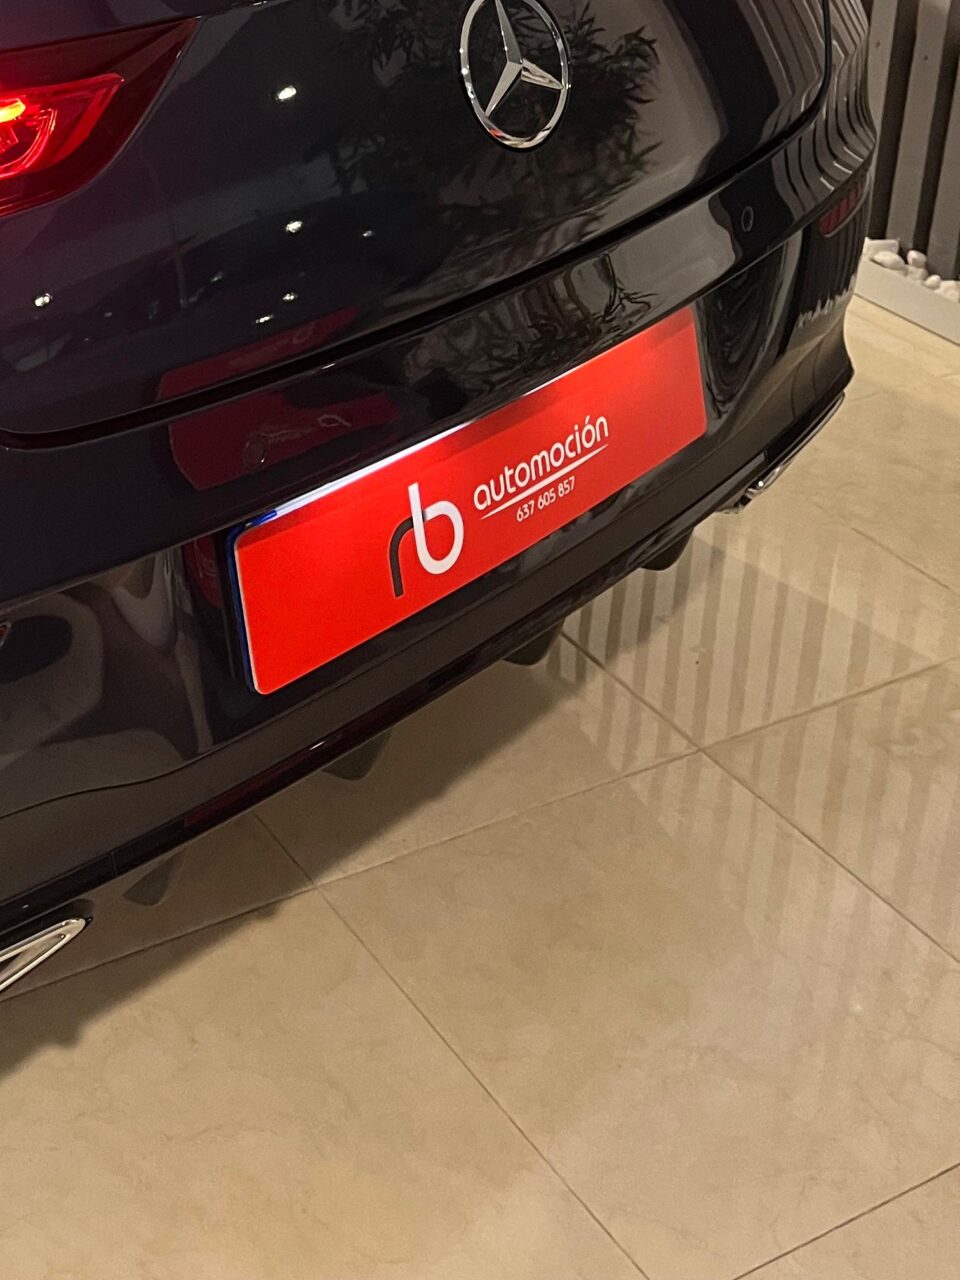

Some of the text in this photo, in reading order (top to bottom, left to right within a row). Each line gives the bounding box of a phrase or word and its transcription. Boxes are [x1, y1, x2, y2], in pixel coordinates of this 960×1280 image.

[473, 415, 609, 510] automoción
[516, 476, 576, 522] 637 605 857
